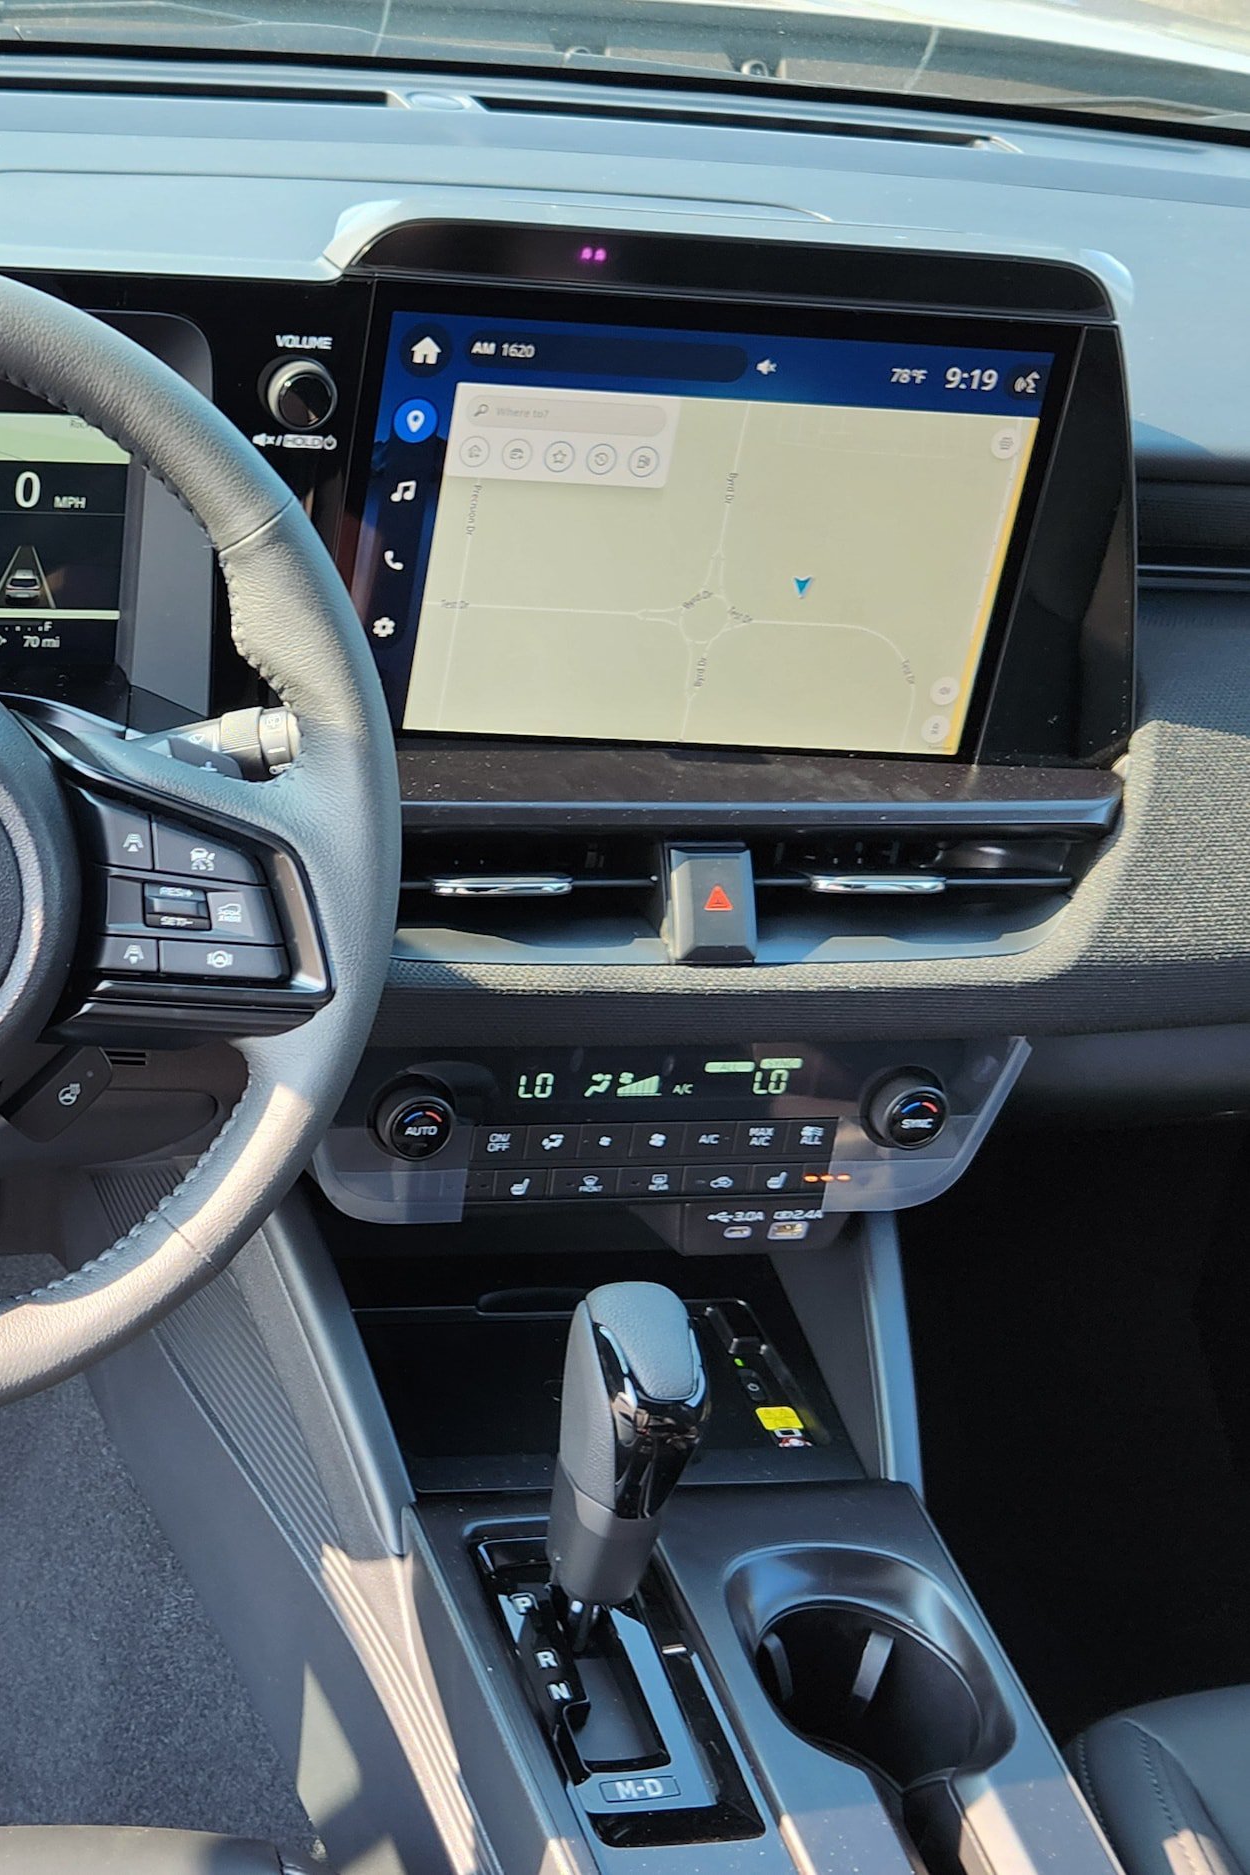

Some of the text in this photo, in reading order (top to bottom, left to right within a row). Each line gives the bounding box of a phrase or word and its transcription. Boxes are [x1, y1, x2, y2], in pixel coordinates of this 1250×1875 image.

[275, 335, 333, 349] VOLUME
[471, 342, 535, 358] AM 1620
[945, 367, 999, 391] 9:19
[497, 407, 529, 418] Where
[15, 471, 41, 508] 0
[54, 495, 86, 509] MPH
[44, 620, 53, 632] F
[517, 1072, 554, 1099] LO
[672, 1083, 694, 1095] A/C
[753, 1069, 789, 1095] LO
[901, 1118, 933, 1129] SYNC
[404, 1125, 438, 1137] AUTO
[749, 1127, 774, 1138] MAX
[699, 1134, 720, 1145] A/C
[749, 1136, 771, 1147] A/C
[800, 1135, 822, 1146] ALL
[486, 1142, 510, 1153] OFF
[513, 1596, 533, 1614] P
[537, 1651, 558, 1668] R
[548, 1683, 570, 1700] N
[616, 1779, 664, 1799] M-D
